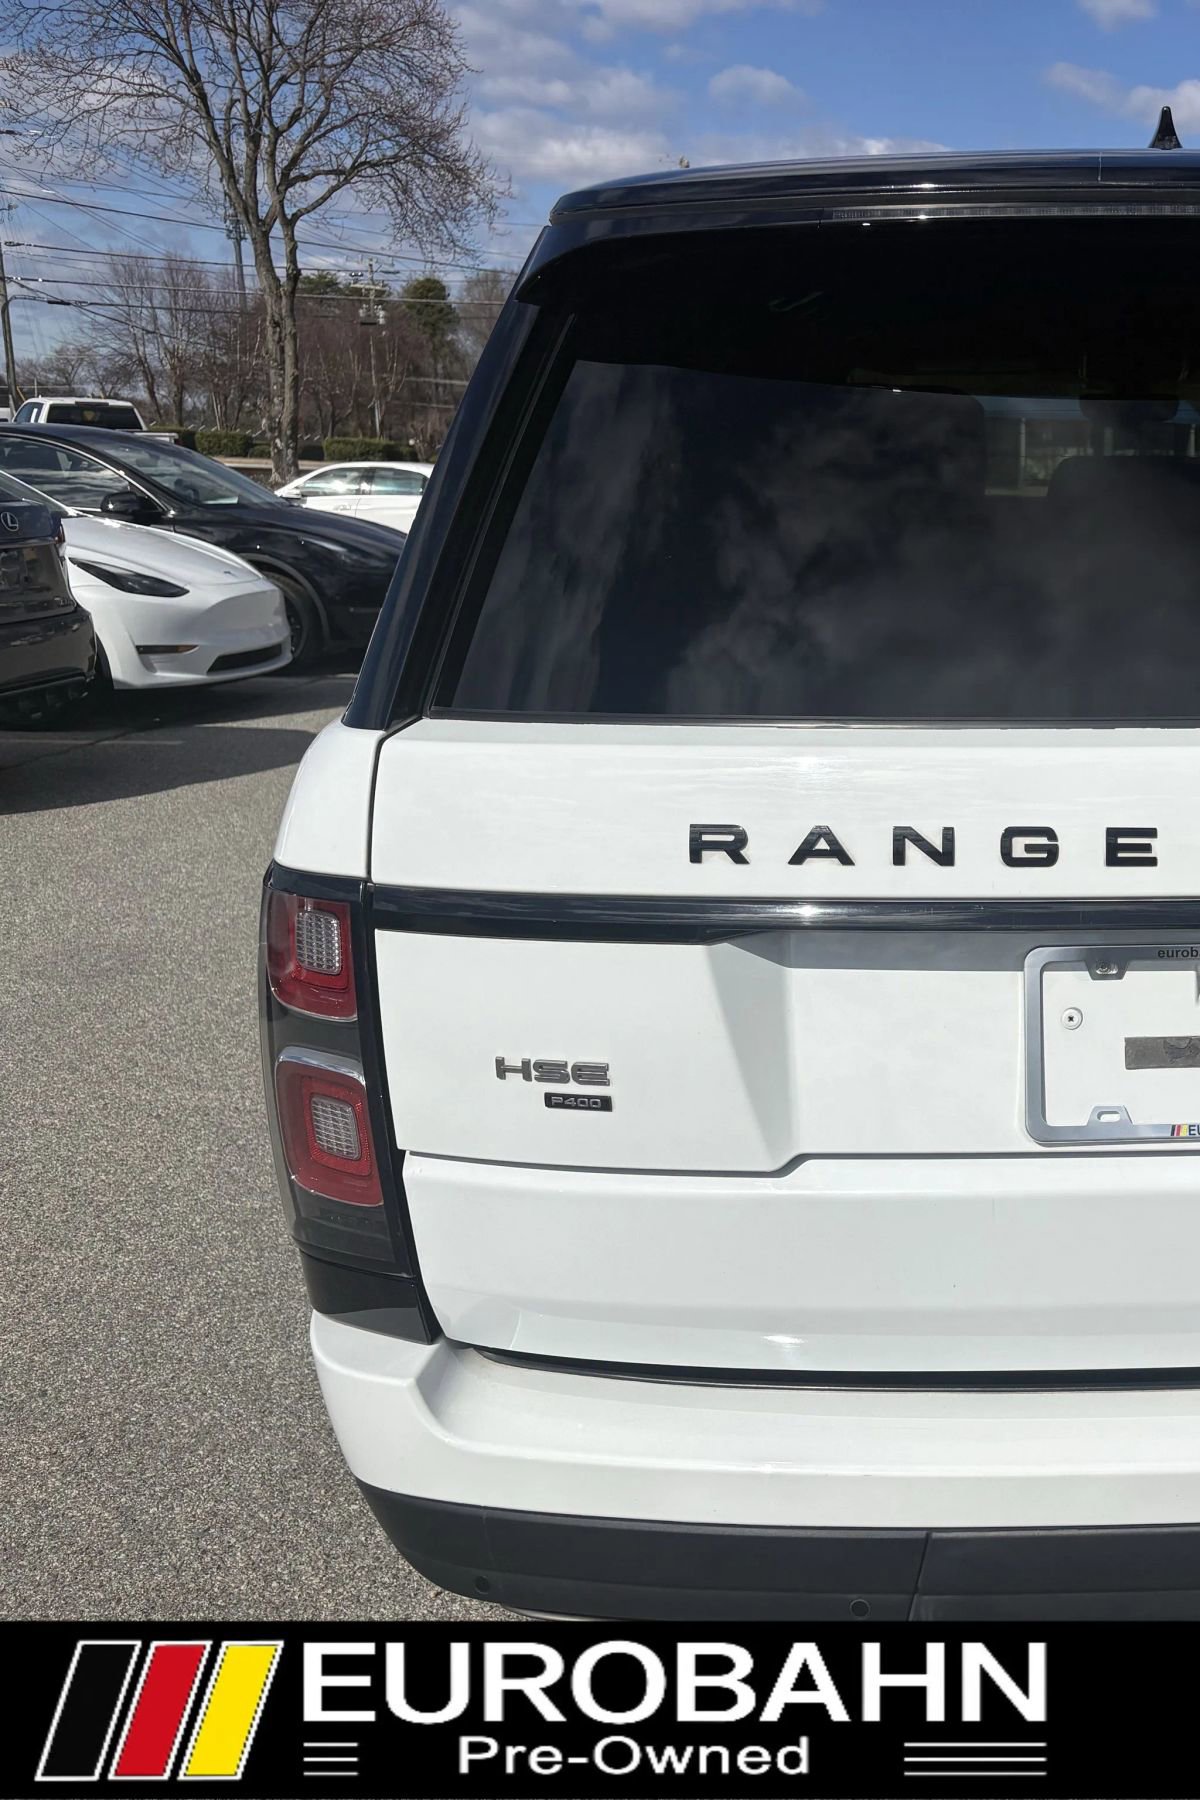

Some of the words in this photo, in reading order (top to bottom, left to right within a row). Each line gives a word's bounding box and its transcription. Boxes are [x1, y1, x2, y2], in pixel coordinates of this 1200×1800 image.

[690, 824, 1158, 867] RANGE
[495, 1056, 611, 1087] HSE
[551, 1096, 602, 1109] P400
